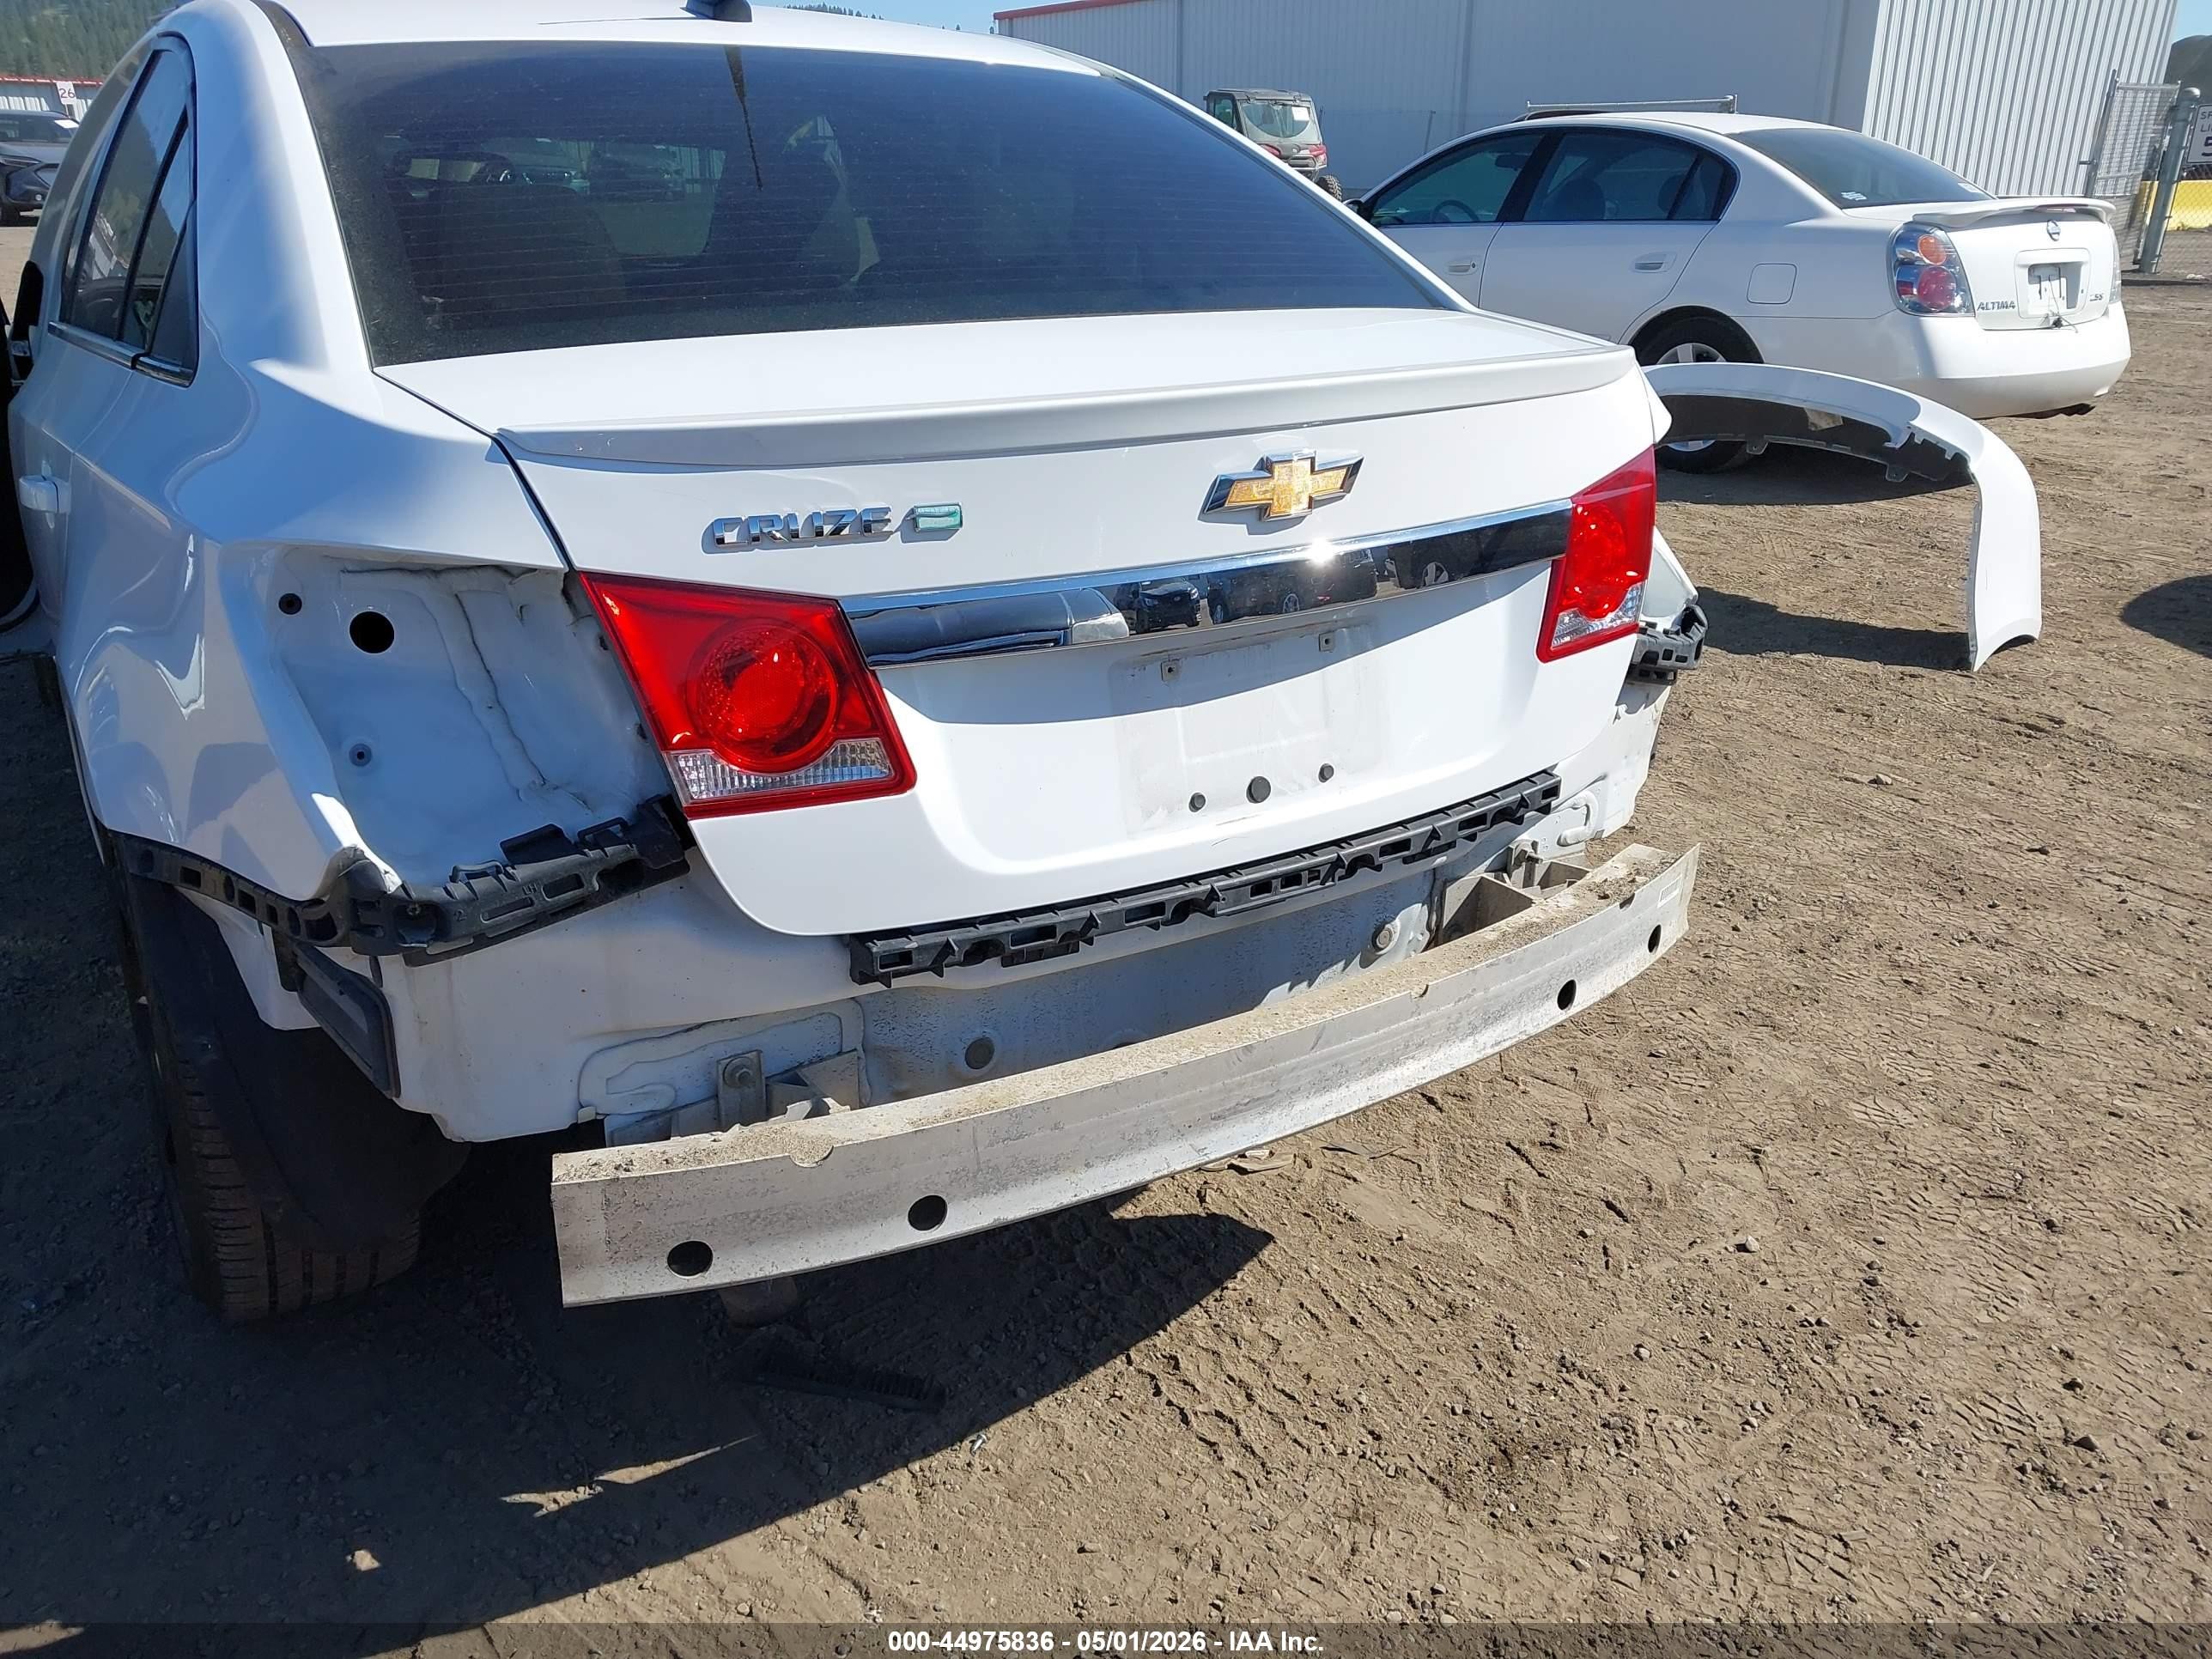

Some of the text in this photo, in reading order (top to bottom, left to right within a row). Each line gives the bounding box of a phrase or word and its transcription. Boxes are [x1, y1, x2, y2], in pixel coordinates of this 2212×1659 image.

[58, 88, 76, 99] 26
[1977, 300, 2016, 312] ALTIMA
[714, 505, 893, 547] CRUZE
